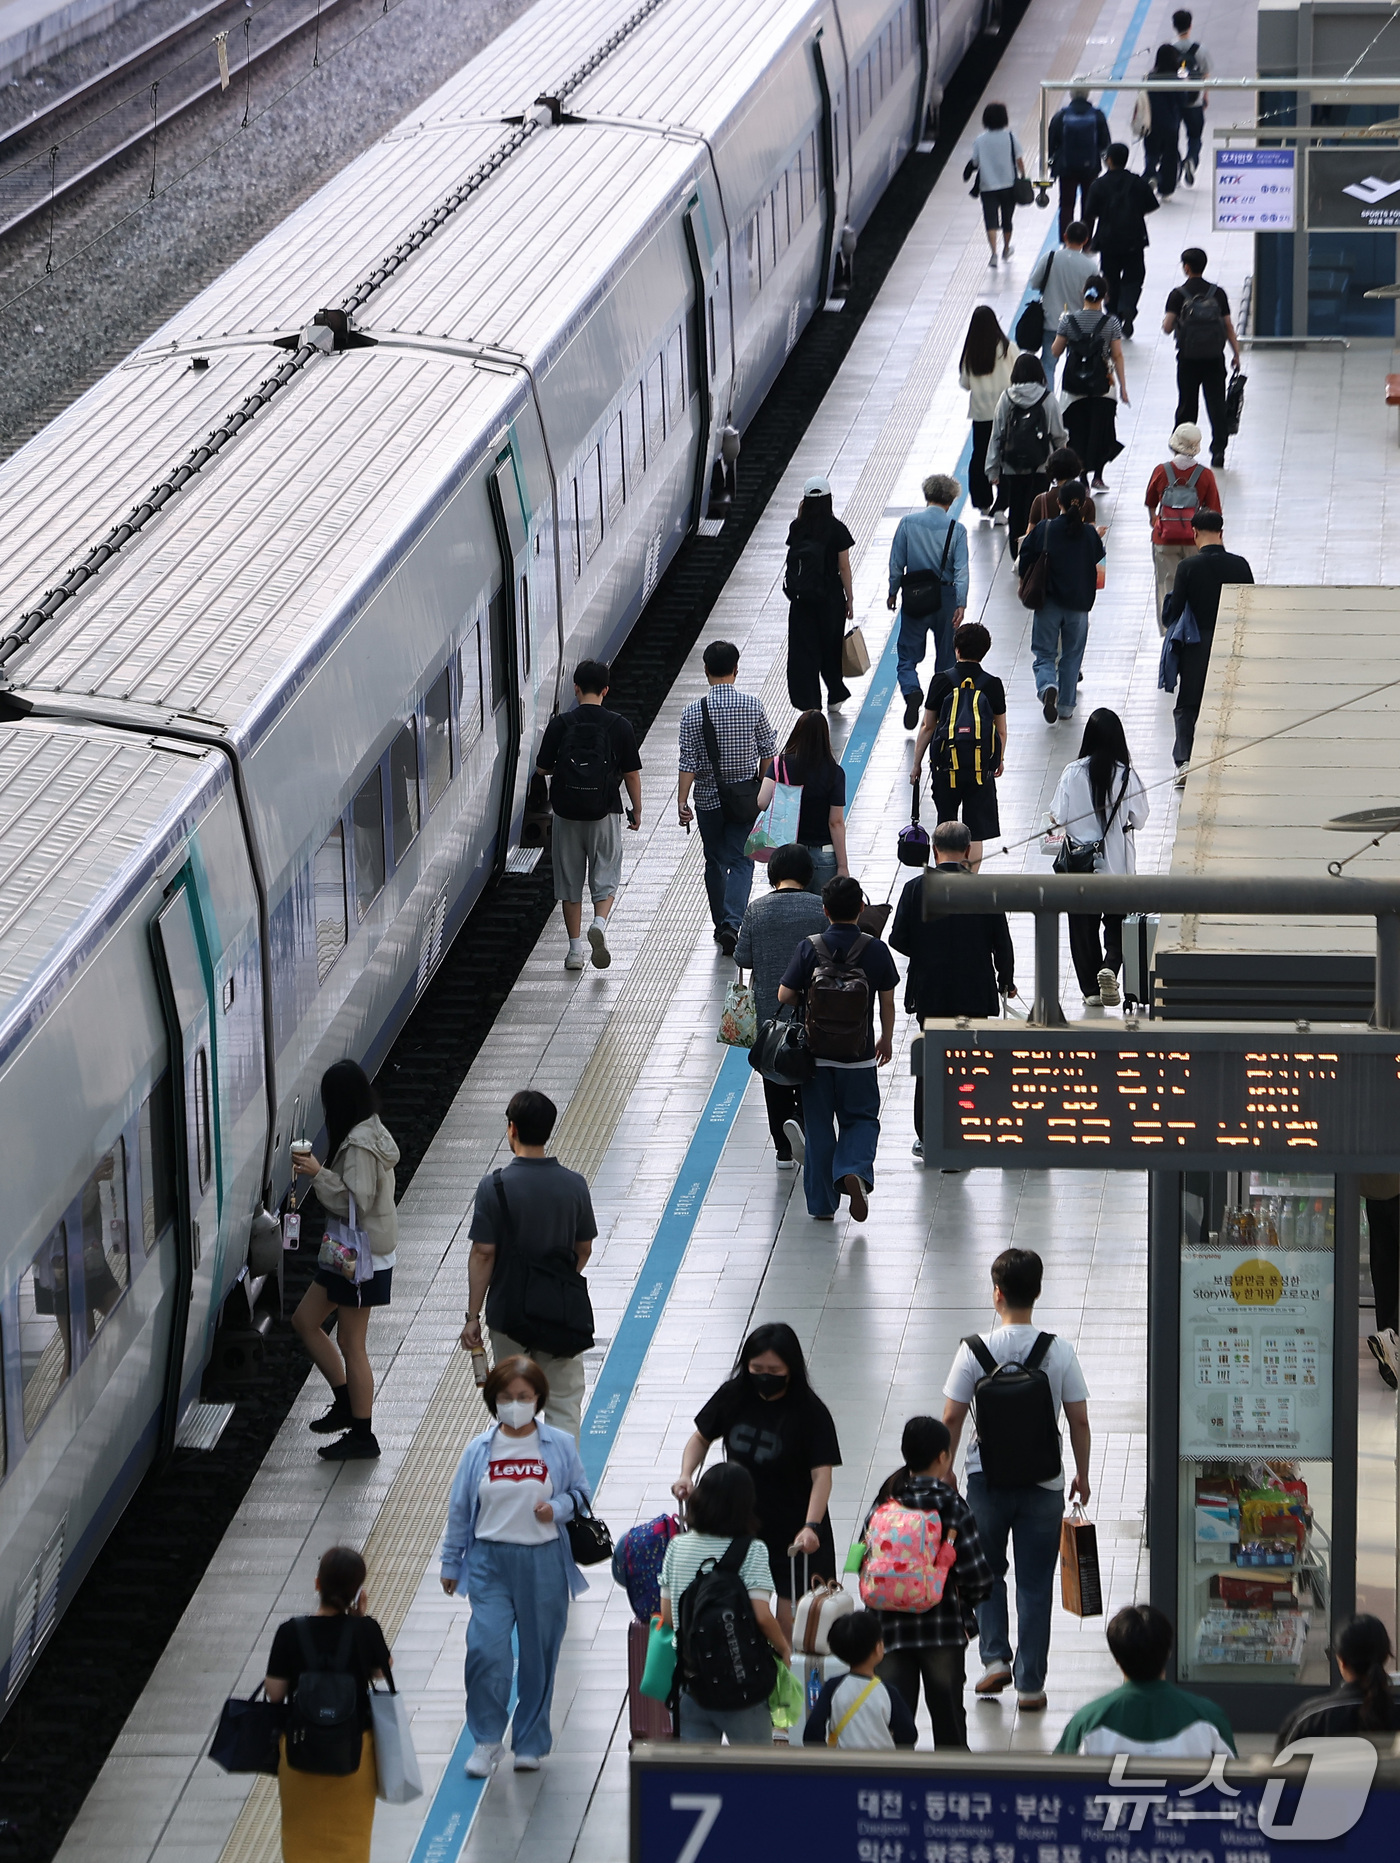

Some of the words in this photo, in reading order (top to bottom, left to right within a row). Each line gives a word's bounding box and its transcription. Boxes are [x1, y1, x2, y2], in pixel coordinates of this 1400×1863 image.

[1219, 174, 1246, 184] KTX
[1219, 195, 1240, 204] KTX
[1219, 213, 1240, 223] KTX
[1361, 210, 1388, 218] SPORTS
[1213, 1275, 1265, 1287] 보름달만큼
[1269, 1275, 1300, 1288] 풍성한
[1193, 1289, 1240, 1300] StoryWay
[1244, 1288, 1275, 1300] 한가위
[1279, 1288, 1320, 1301] 프로모션
[857, 1789, 903, 1820] 대전
[925, 1791, 993, 1821] 동대구
[1015, 1793, 1061, 1824] 부산
[670, 1793, 723, 1863] 7
[857, 1839, 904, 1863] 익산
